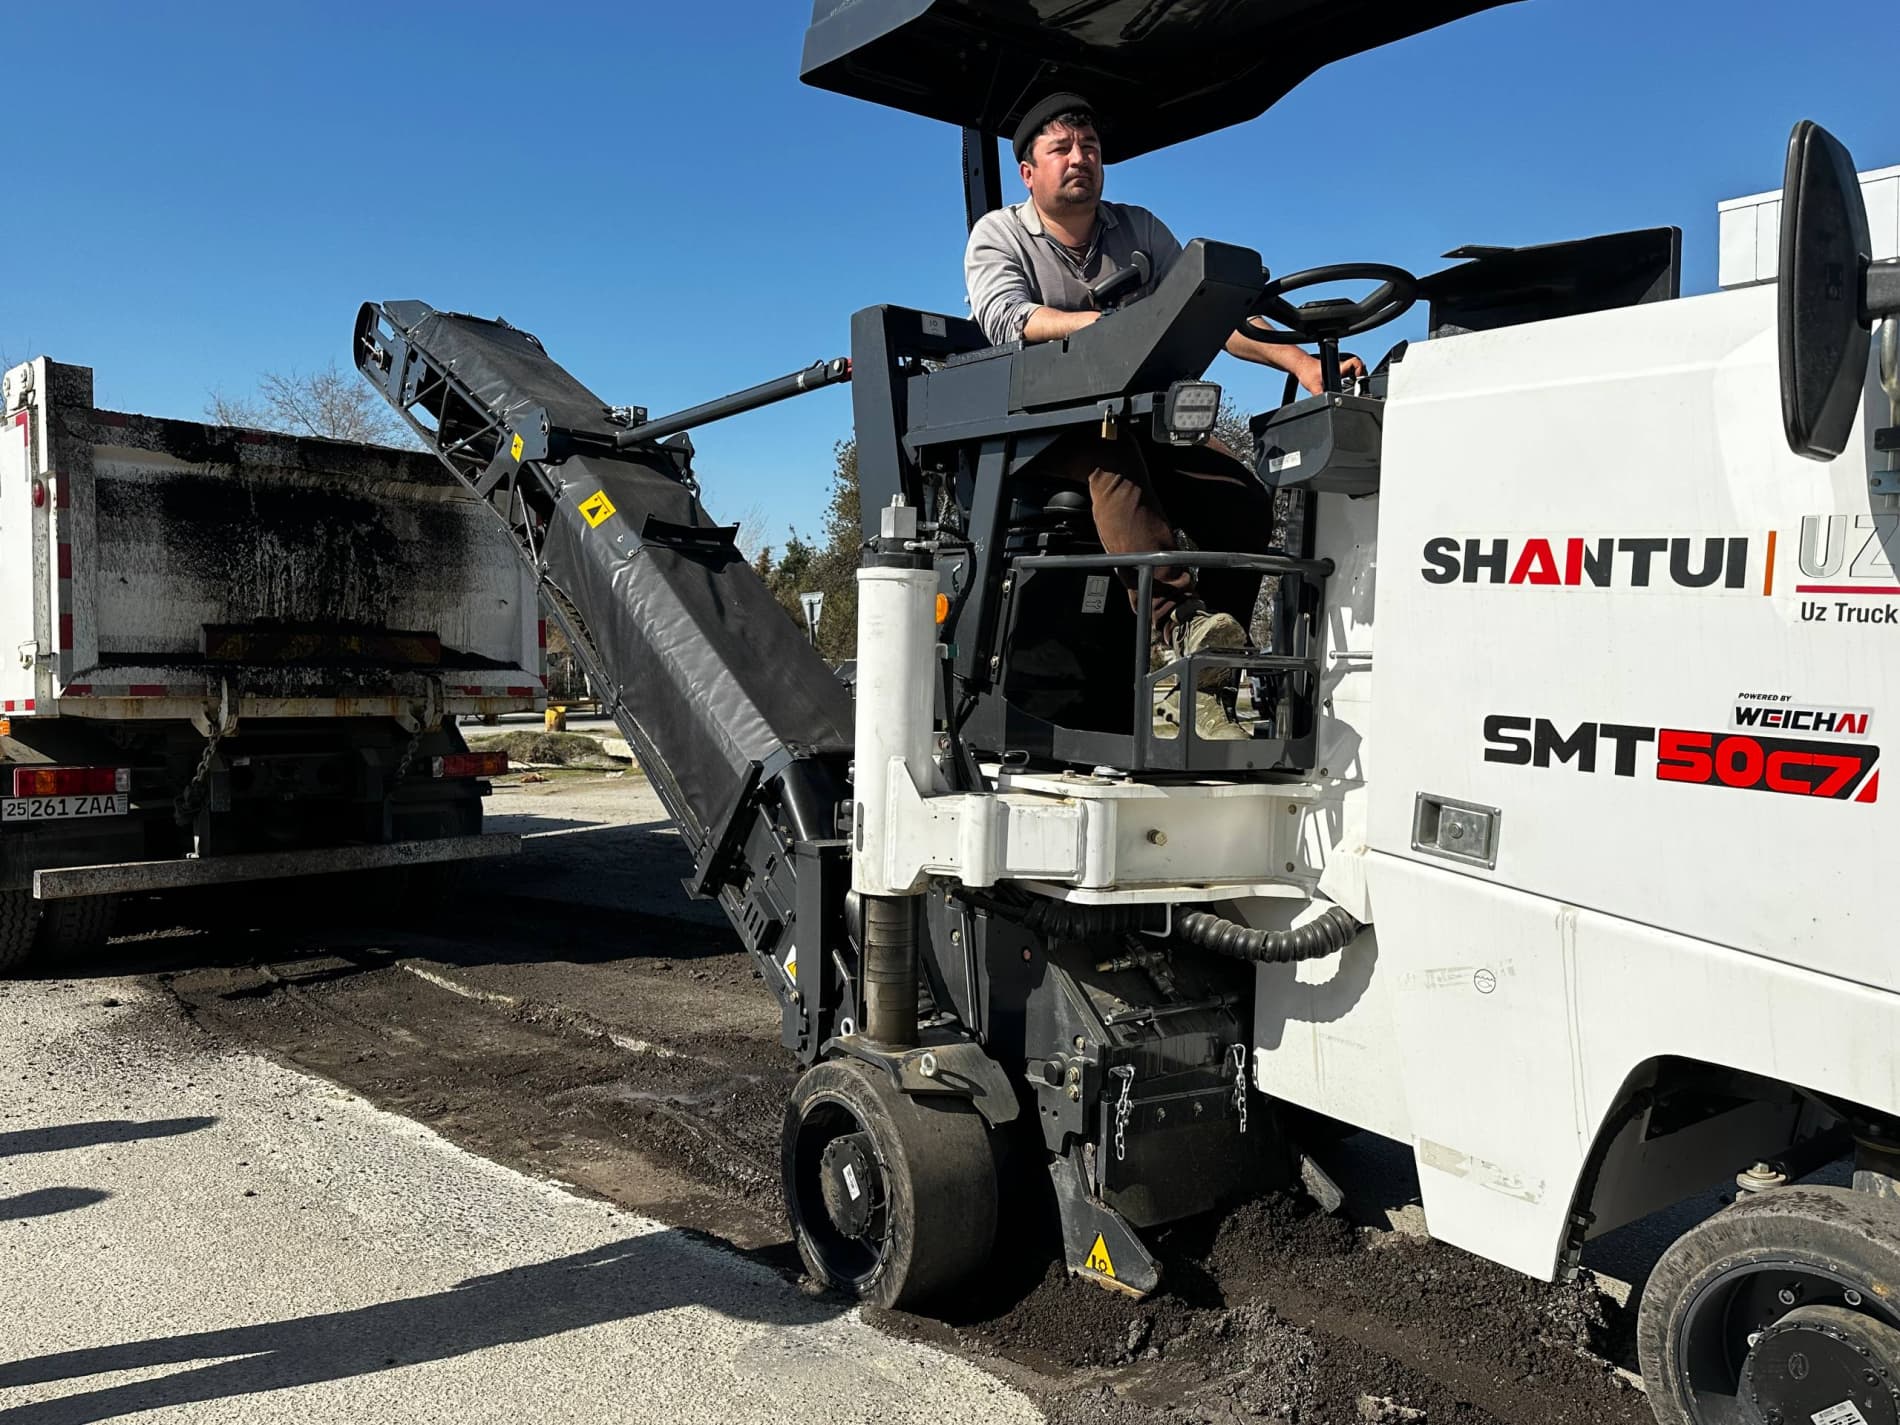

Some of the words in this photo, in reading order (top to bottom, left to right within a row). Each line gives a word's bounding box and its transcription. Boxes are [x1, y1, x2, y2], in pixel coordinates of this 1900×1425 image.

[1798, 513, 1900, 578] UZ
[1421, 537, 1748, 588] SHANTUI
[1801, 601, 1827, 621] Uz
[1834, 602, 1899, 624] Truck
[1738, 692, 1779, 701] POWERED
[1735, 706, 1868, 734] WEICHAI
[7, 803, 27, 816] 25
[31, 799, 68, 817] 261
[75, 796, 116, 815] ZAA
